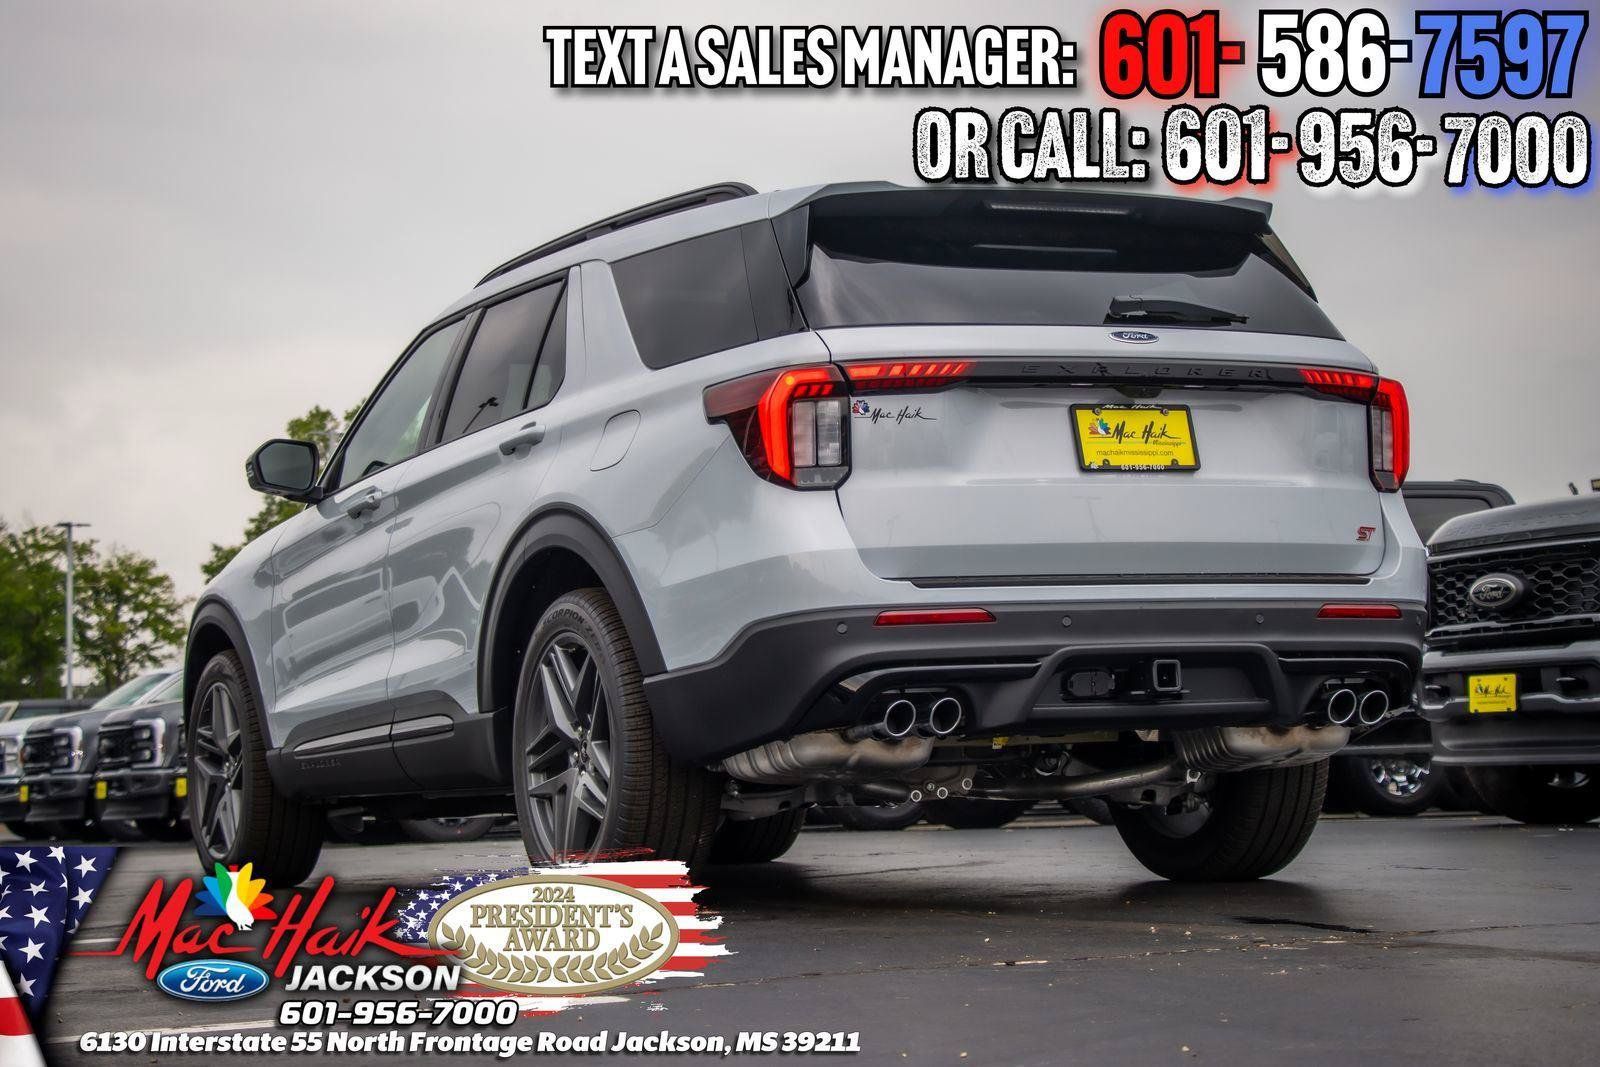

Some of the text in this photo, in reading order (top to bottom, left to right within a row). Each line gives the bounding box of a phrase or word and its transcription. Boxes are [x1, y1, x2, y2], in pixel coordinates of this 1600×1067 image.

[1021, 362, 1272, 381] EXPLORER
[869, 405, 937, 425] Mac Haik
[1111, 420, 1180, 444] Mac Haik
[1356, 526, 1376, 541] ST
